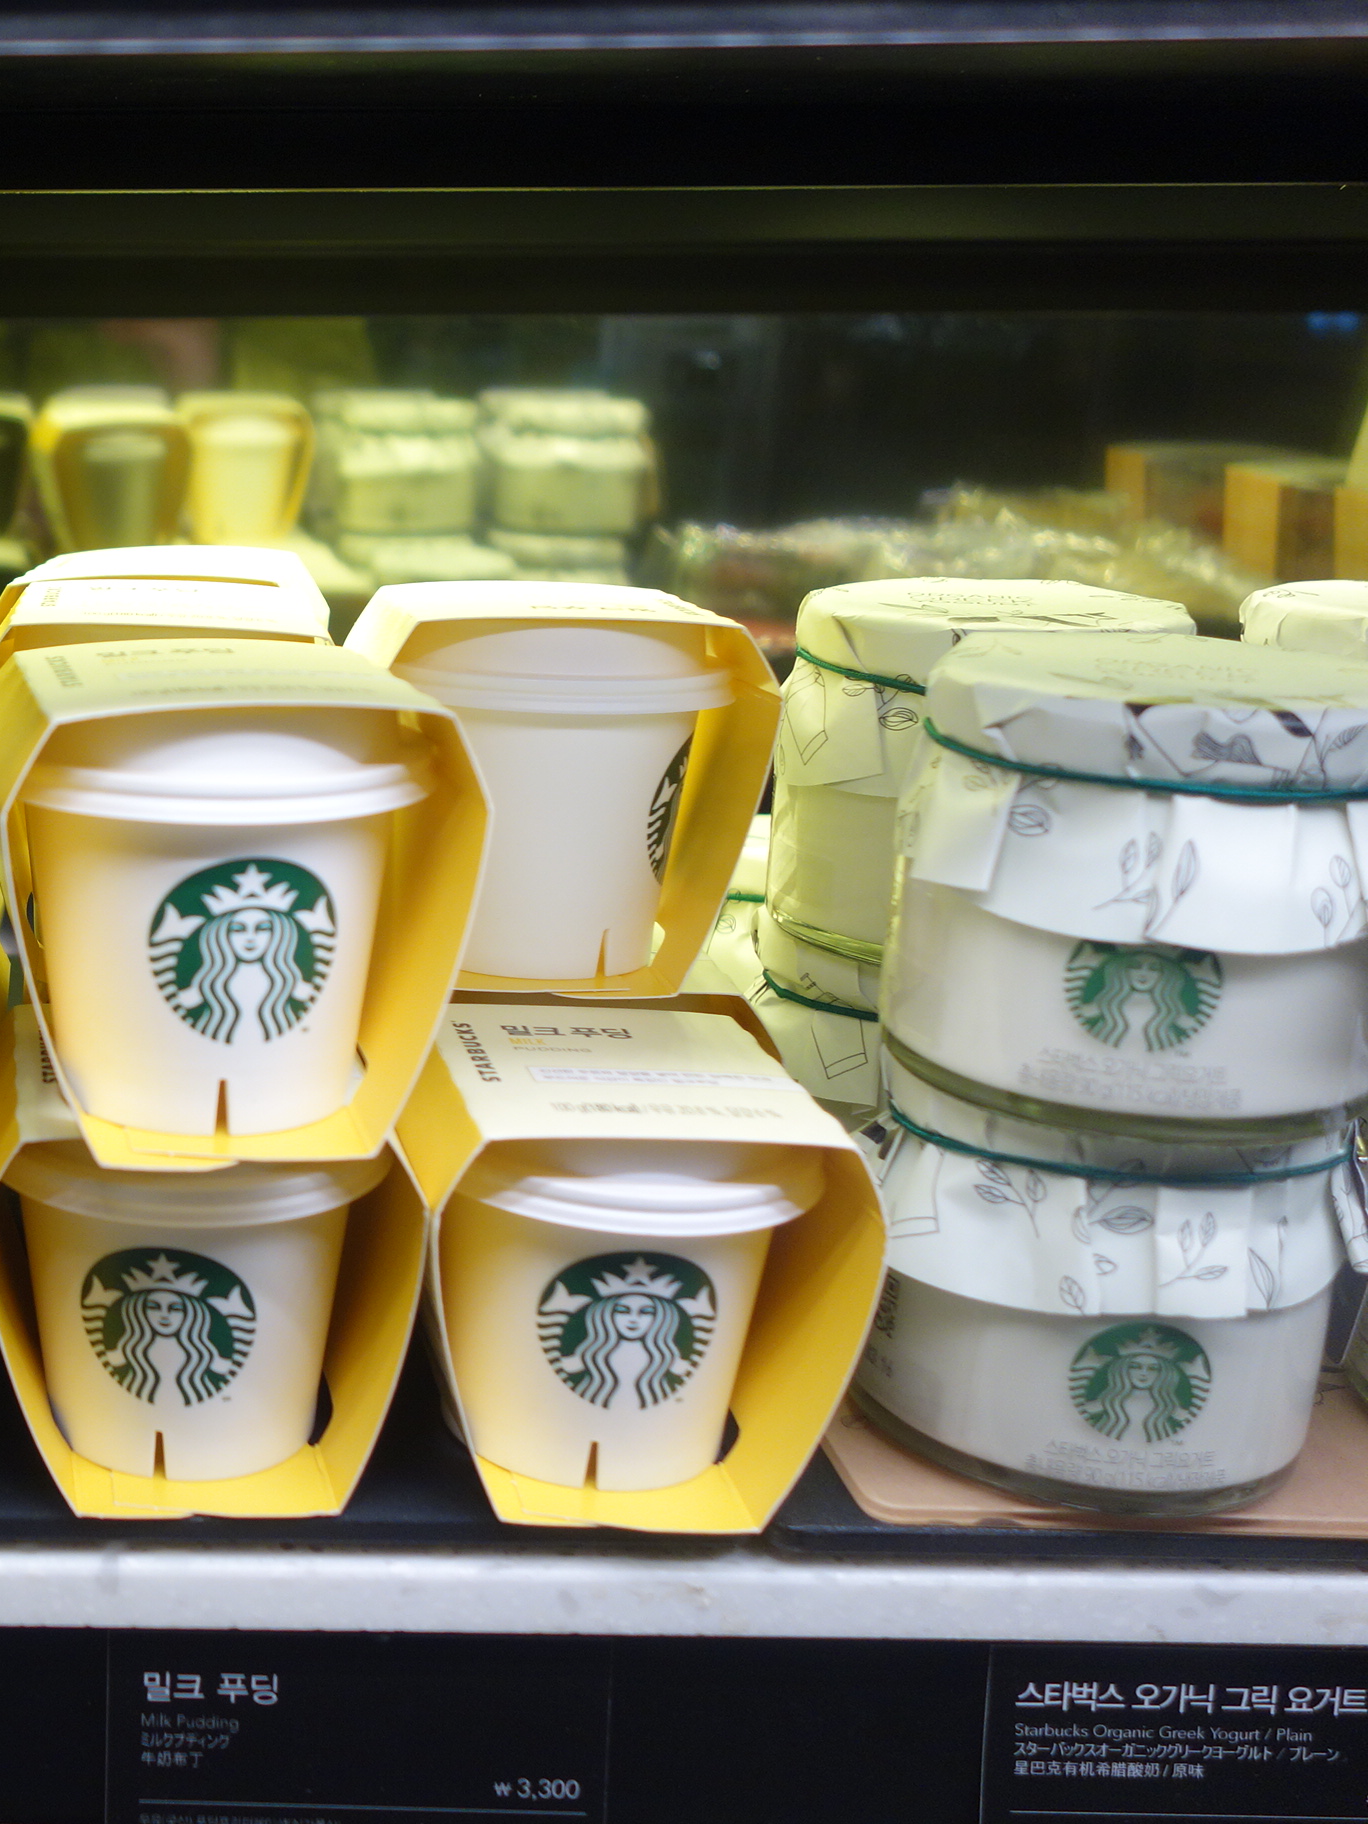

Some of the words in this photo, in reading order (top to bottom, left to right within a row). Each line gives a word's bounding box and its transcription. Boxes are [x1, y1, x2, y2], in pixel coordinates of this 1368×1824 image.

[500, 1025, 566, 1036] 밀크
[569, 1026, 633, 1040] 푸딩
[508, 1037, 547, 1046] MILK
[452, 1021, 502, 1082] STARBUCKS
[143, 1671, 205, 1702] 밀크
[216, 1672, 279, 1706] 푸딩
[1014, 1680, 1127, 1712] 스타벅스
[1131, 1683, 1215, 1715] 오가닉
[1221, 1685, 1280, 1716] 그릭
[1283, 1686, 1368, 1717] 요거트
[141, 1712, 172, 1728] Milk
[177, 1713, 240, 1734] Pudding
[1014, 1722, 1089, 1738] Starbucks
[1092, 1723, 1155, 1742] Organic
[1158, 1725, 1206, 1740] Greek
[1209, 1727, 1260, 1744] Yogurt
[1276, 1727, 1313, 1742] Plain
[1013, 1760, 1160, 1778] 星巴克有机希腊酸奶
[1171, 1762, 1206, 1779] 原味
[516, 1777, 581, 1801] 3,300
